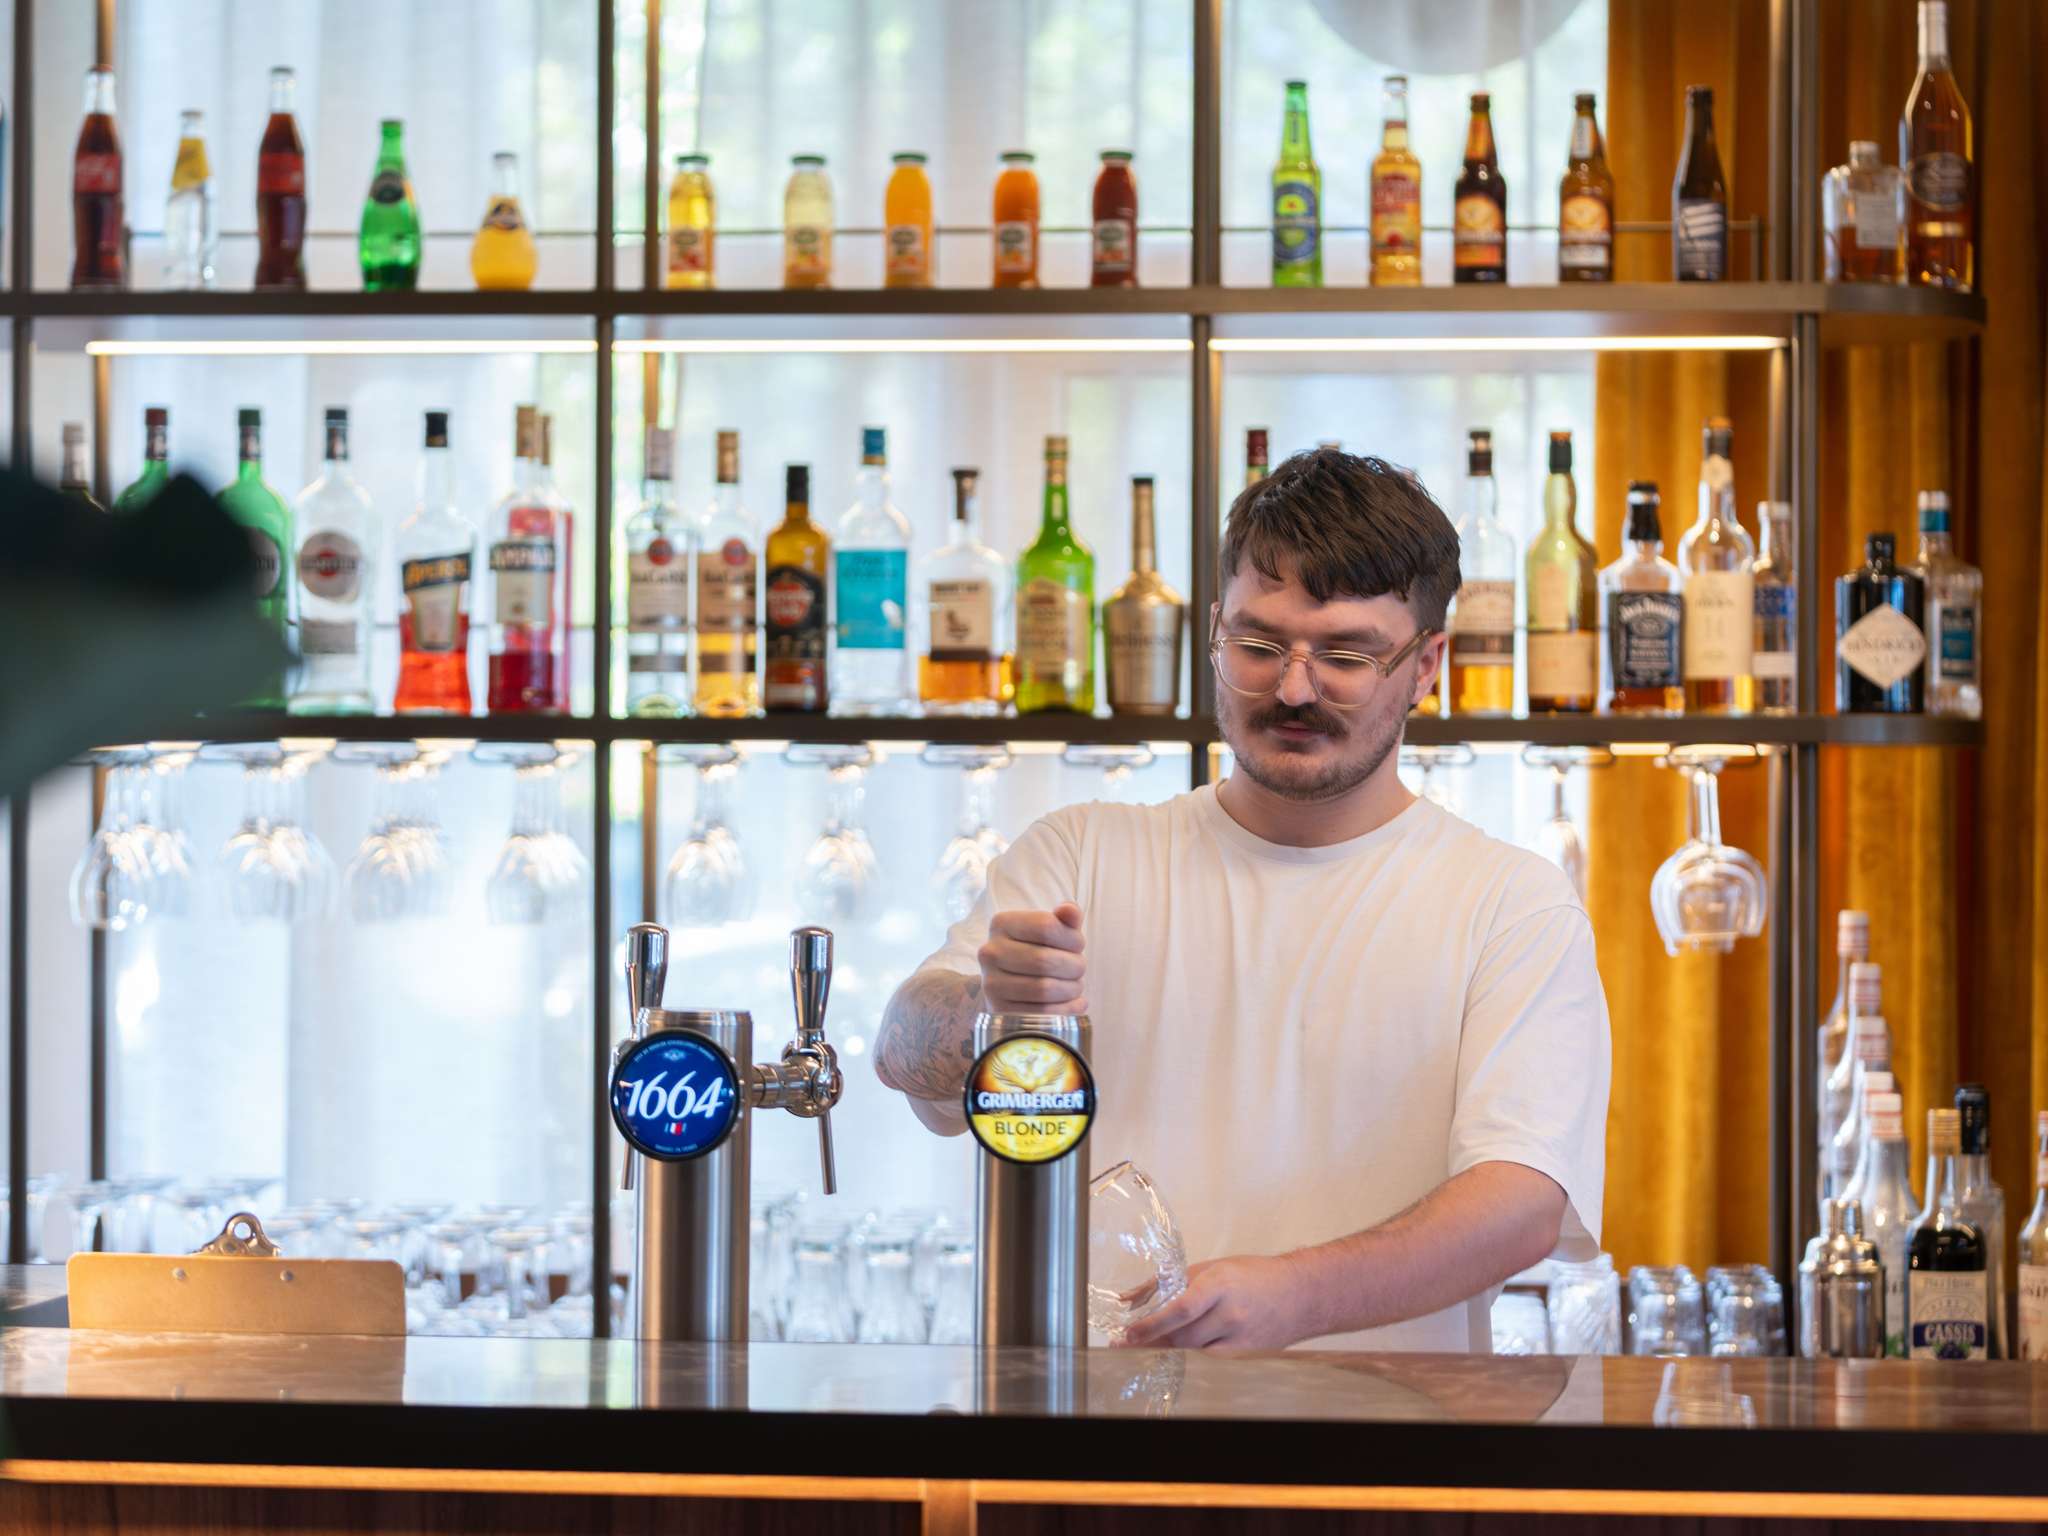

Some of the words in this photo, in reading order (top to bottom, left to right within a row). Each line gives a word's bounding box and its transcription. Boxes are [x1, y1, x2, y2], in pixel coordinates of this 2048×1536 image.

[623, 1070, 724, 1120] 1664
[977, 1089, 1085, 1110] GRIMBERGEN
[995, 1121, 1067, 1136] BLONDE
[1924, 1322, 1976, 1345] CASSIS
